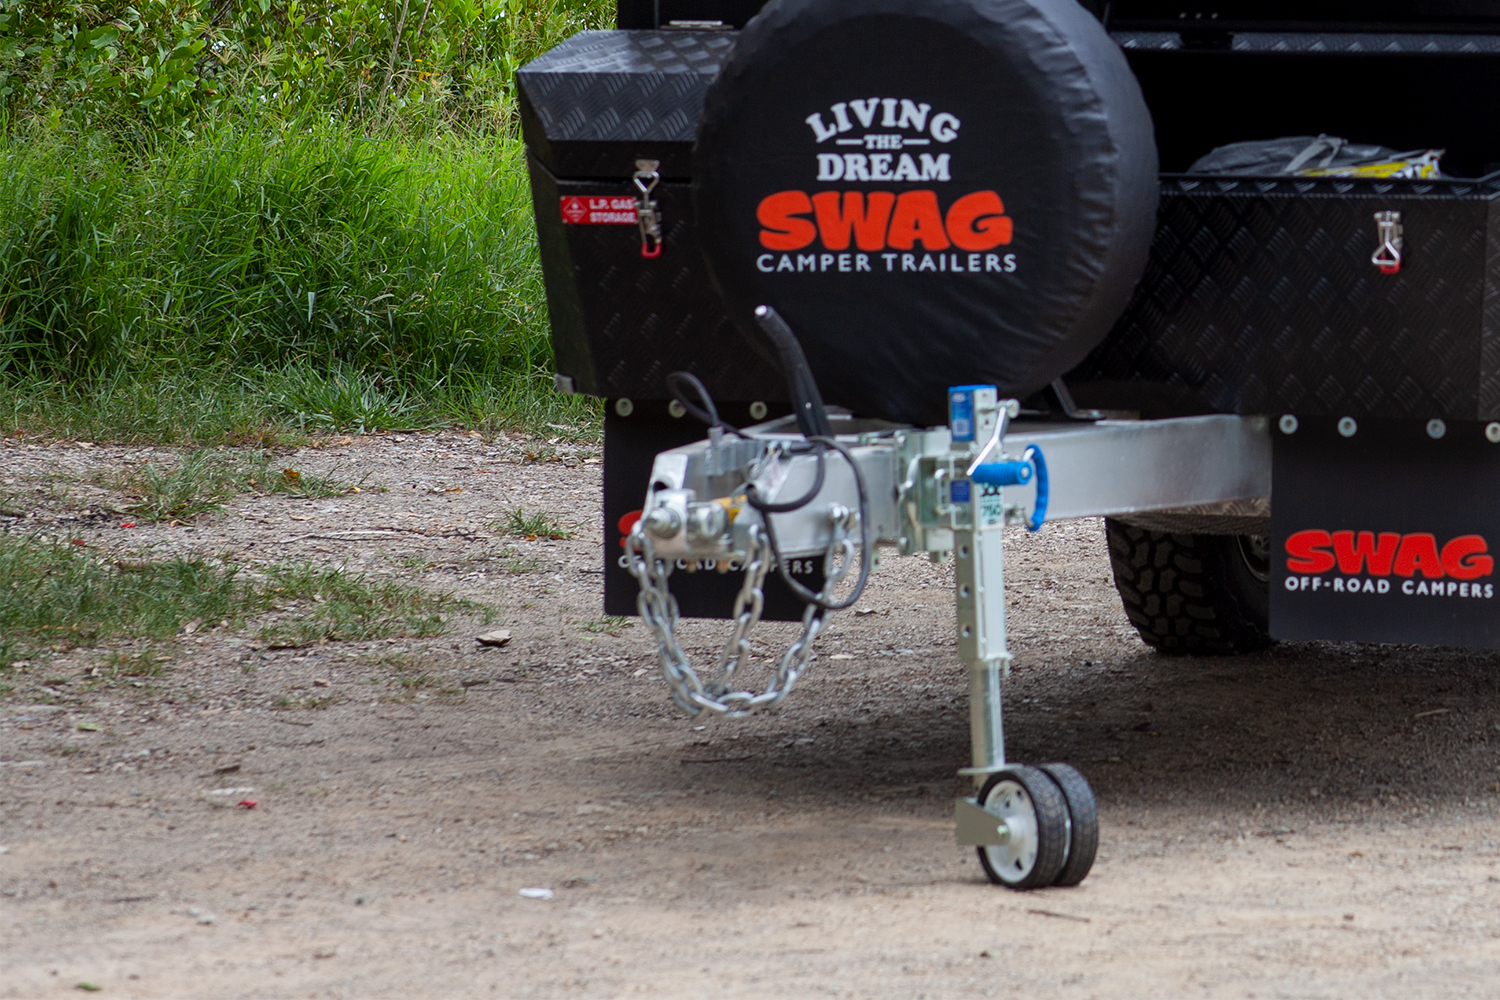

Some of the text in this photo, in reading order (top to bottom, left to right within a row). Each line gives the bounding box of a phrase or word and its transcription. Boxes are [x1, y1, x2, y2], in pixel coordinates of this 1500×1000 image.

[804, 97, 962, 144] LIVING
[863, 134, 904, 150] THE
[816, 153, 952, 182] DREAM
[611, 199, 635, 210] GAS
[589, 211, 636, 223] STORAGE
[756, 189, 1014, 252] SWAG
[756, 253, 1017, 273] CAMPER TRAILERS
[1284, 529, 1494, 580] SWAG
[1284, 576, 1494, 599] OFF-ROAD CAMPERS
